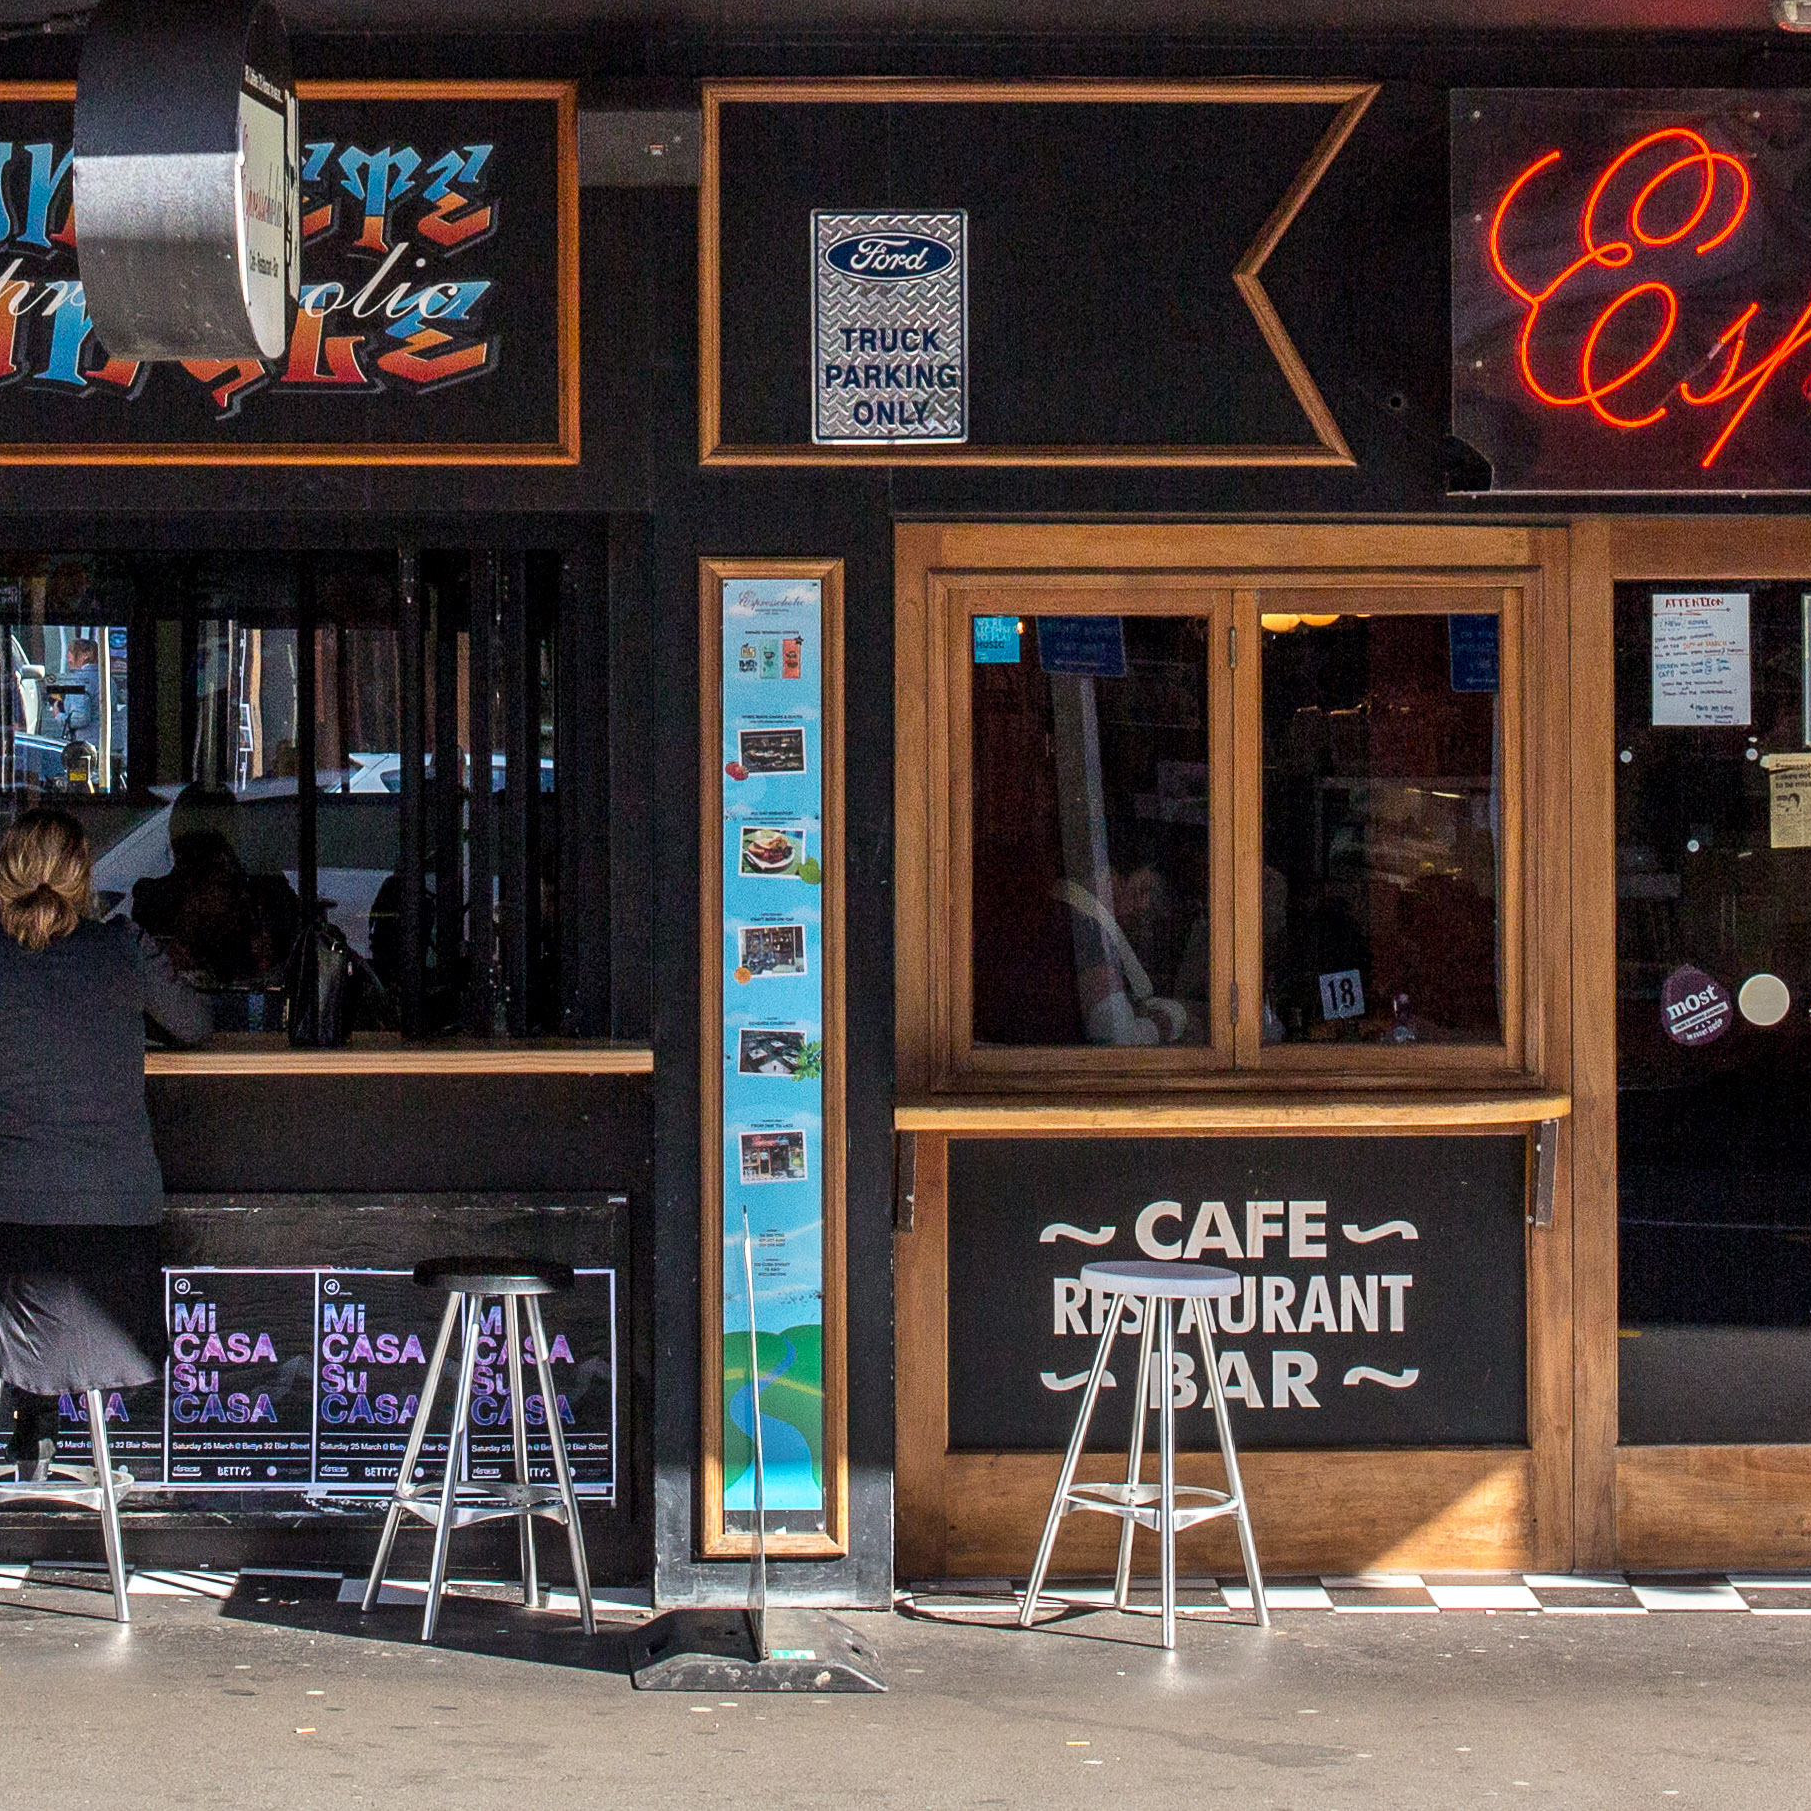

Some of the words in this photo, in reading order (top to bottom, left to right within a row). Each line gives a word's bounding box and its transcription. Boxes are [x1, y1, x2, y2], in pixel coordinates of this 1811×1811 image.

[850, 238, 928, 270] Ford
[840, 328, 940, 352] TRUCK
[825, 364, 958, 389] PARKING
[853, 401, 929, 426] ONLY
[1665, 596, 1724, 609] ATTENTION
[1328, 978, 1355, 1008] 18
[1666, 985, 1719, 1020] most
[1135, 1200, 1328, 1260] CAFE
[174, 1302, 216, 1332] Mi
[323, 1303, 366, 1333] Mi
[479, 1305, 503, 1335] M
[173, 1332, 278, 1363] CASA
[322, 1333, 426, 1364] CASA
[173, 1363, 219, 1393] Su
[321, 1364, 368, 1393] Su
[1149, 1350, 1321, 1409] BAR
[172, 1393, 278, 1423] CASA
[321, 1393, 420, 1424] CASA
[64, 1441, 86, 1449] March
[126, 1441, 141, 1449] Blair
[141, 1441, 162, 1449] Street
[172, 1442, 201, 1451] Saturday
[202, 1442, 212, 1450] 25
[213, 1442, 234, 1450] March
[242, 1442, 263, 1452] Bettys
[264, 1442, 273, 1450] 32
[274, 1442, 289, 1450] Blair
[289, 1442, 310, 1450] Street
[320, 1442, 349, 1452] Saturday
[350, 1442, 360, 1450] 25
[361, 1442, 382, 1451] March
[390, 1442, 406, 1452] Betty
[471, 1444, 500, 1453] Saturday
[572, 1443, 587, 1451] Blair
[588, 1442, 609, 1450] Street
[217, 1466, 252, 1477] BETTYS
[364, 1466, 399, 1477] BETTYS
[529, 1468, 551, 1477] TTYS
